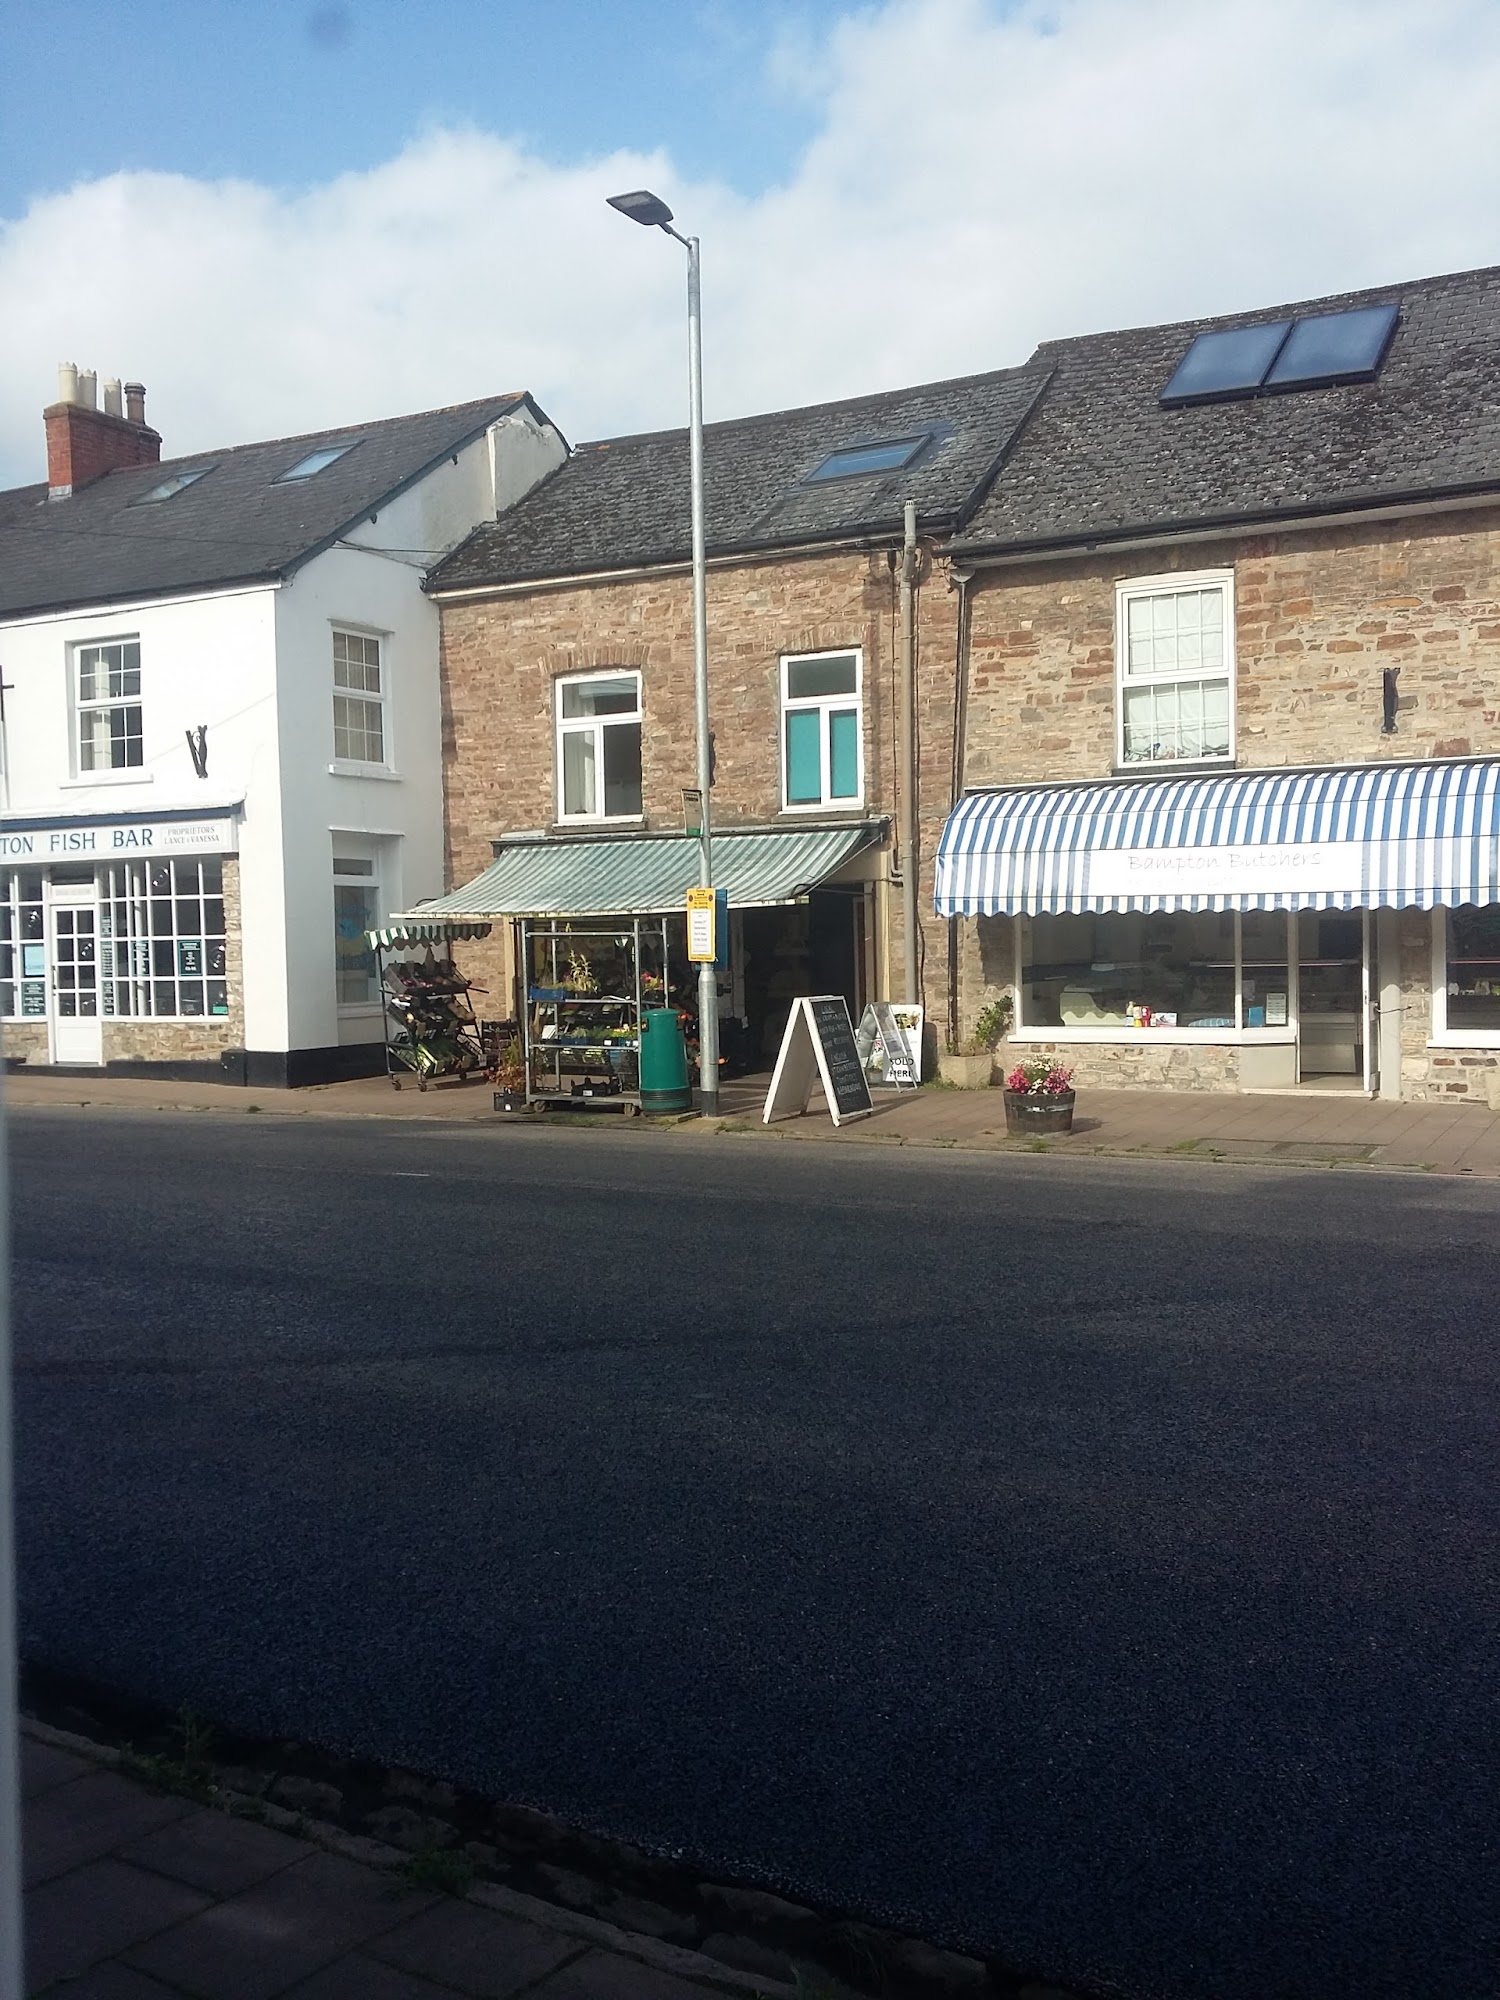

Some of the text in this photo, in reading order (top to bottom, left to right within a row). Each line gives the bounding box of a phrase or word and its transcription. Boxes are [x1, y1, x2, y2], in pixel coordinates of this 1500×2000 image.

[164, 836, 184, 844] LANCE
[190, 834, 220, 843] VANESSA
[167, 826, 215, 836] PROPRIETORS
[50, 832, 96, 851] FISH
[113, 828, 153, 847] BAR
[1128, 851, 1321, 874] Bampton Butchers
